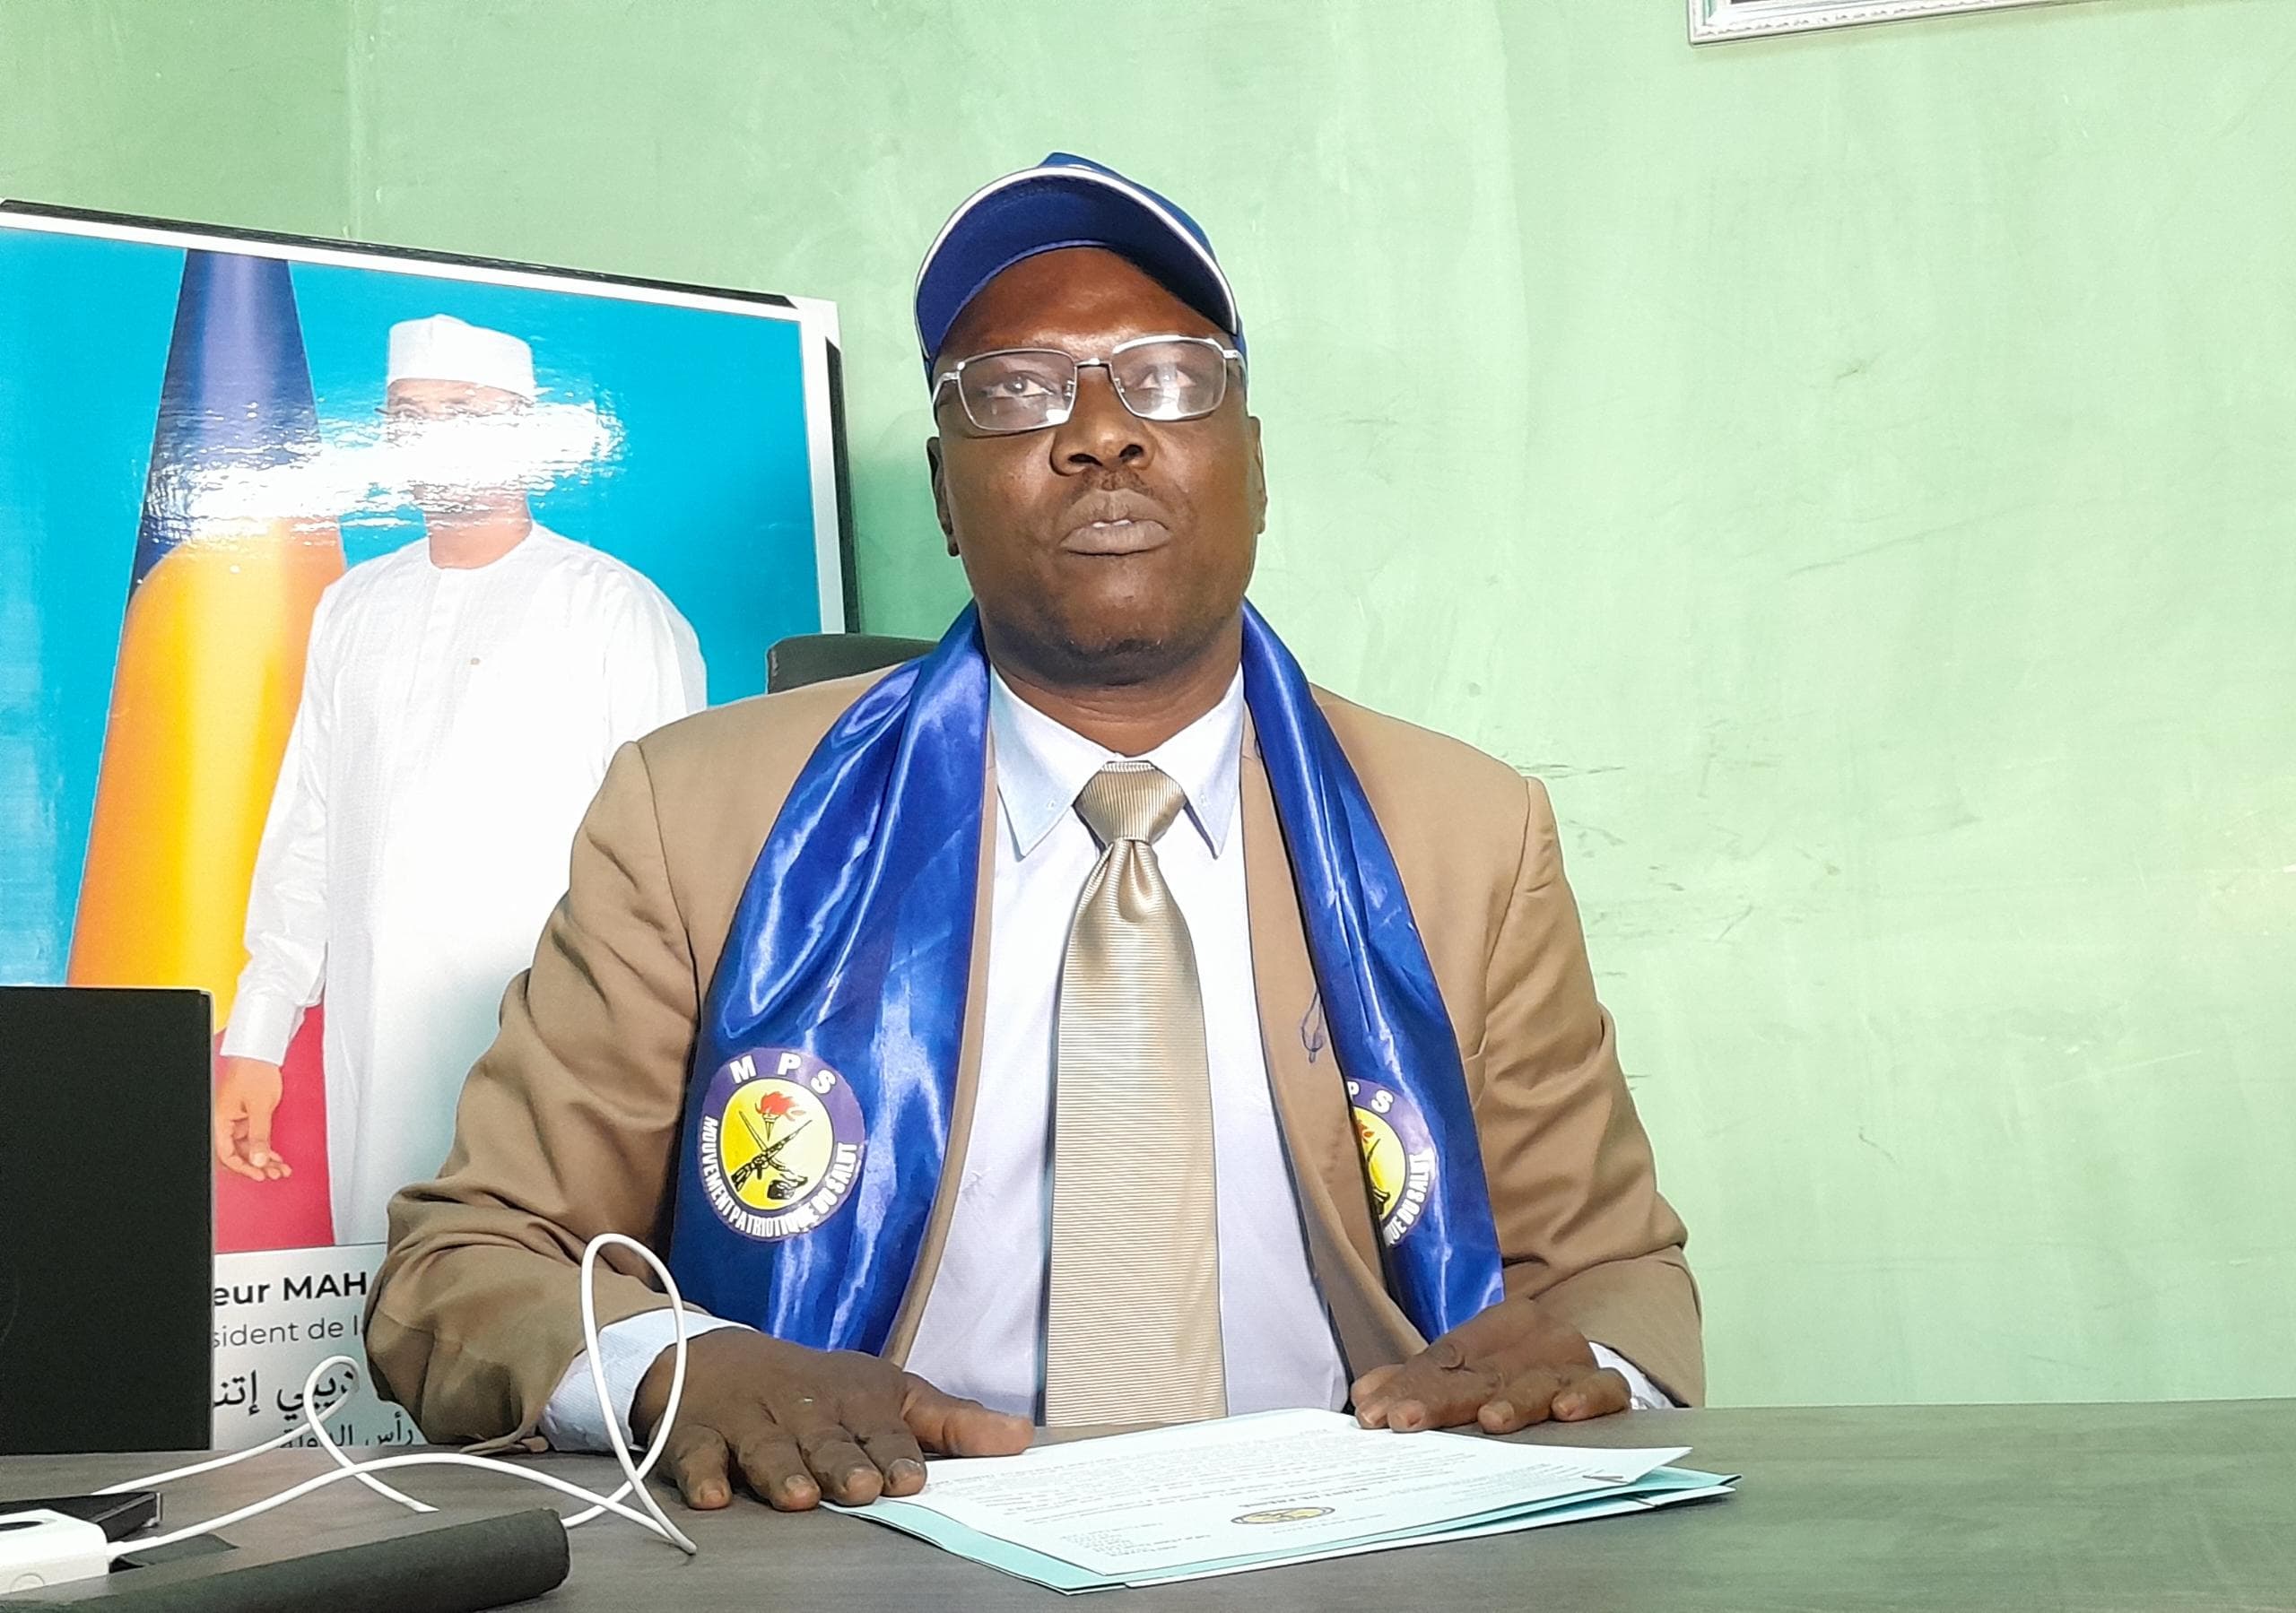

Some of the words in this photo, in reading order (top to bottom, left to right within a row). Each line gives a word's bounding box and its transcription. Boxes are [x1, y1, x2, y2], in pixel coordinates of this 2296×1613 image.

[700, 1115, 735, 1217] MOUVEMENT
[727, 1202, 820, 1238] PATRIOTIQUE
[811, 1187, 838, 1214] DU
[825, 1141, 858, 1194] SALUT
[1396, 1198, 1421, 1226] DU
[214, 1284, 271, 1306] eur
[283, 1271, 368, 1302] MAH
[213, 1322, 300, 1349] sident
[308, 1317, 344, 1340] de
